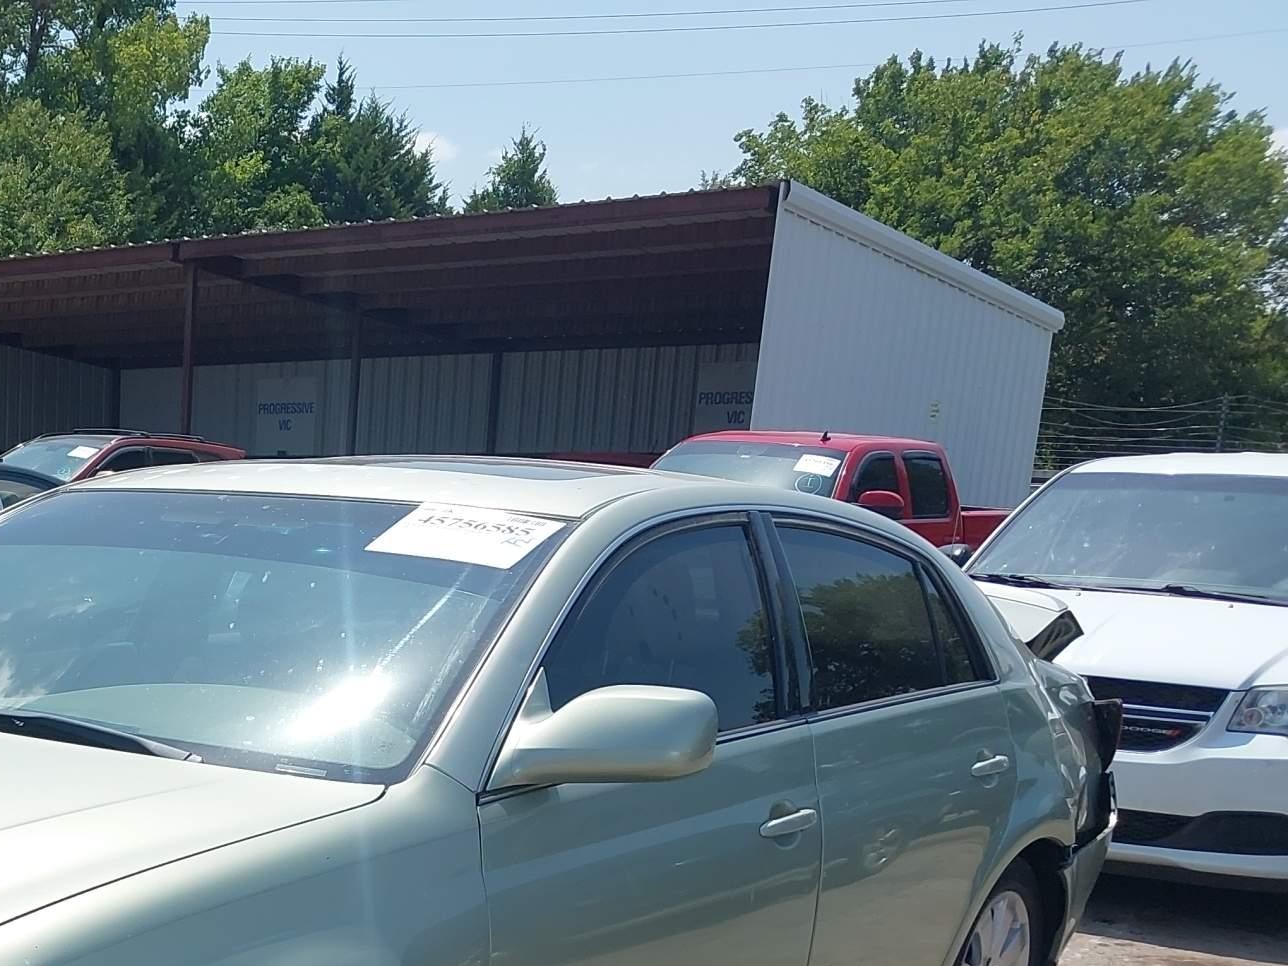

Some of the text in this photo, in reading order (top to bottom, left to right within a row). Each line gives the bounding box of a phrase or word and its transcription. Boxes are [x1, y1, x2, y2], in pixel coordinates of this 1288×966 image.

[698, 391, 754, 405] PROGRES
[258, 402, 315, 414] PROGRESSIVE
[727, 410, 745, 424] VIC
[279, 419, 292, 431] VIC
[418, 515, 536, 536] 45756585
